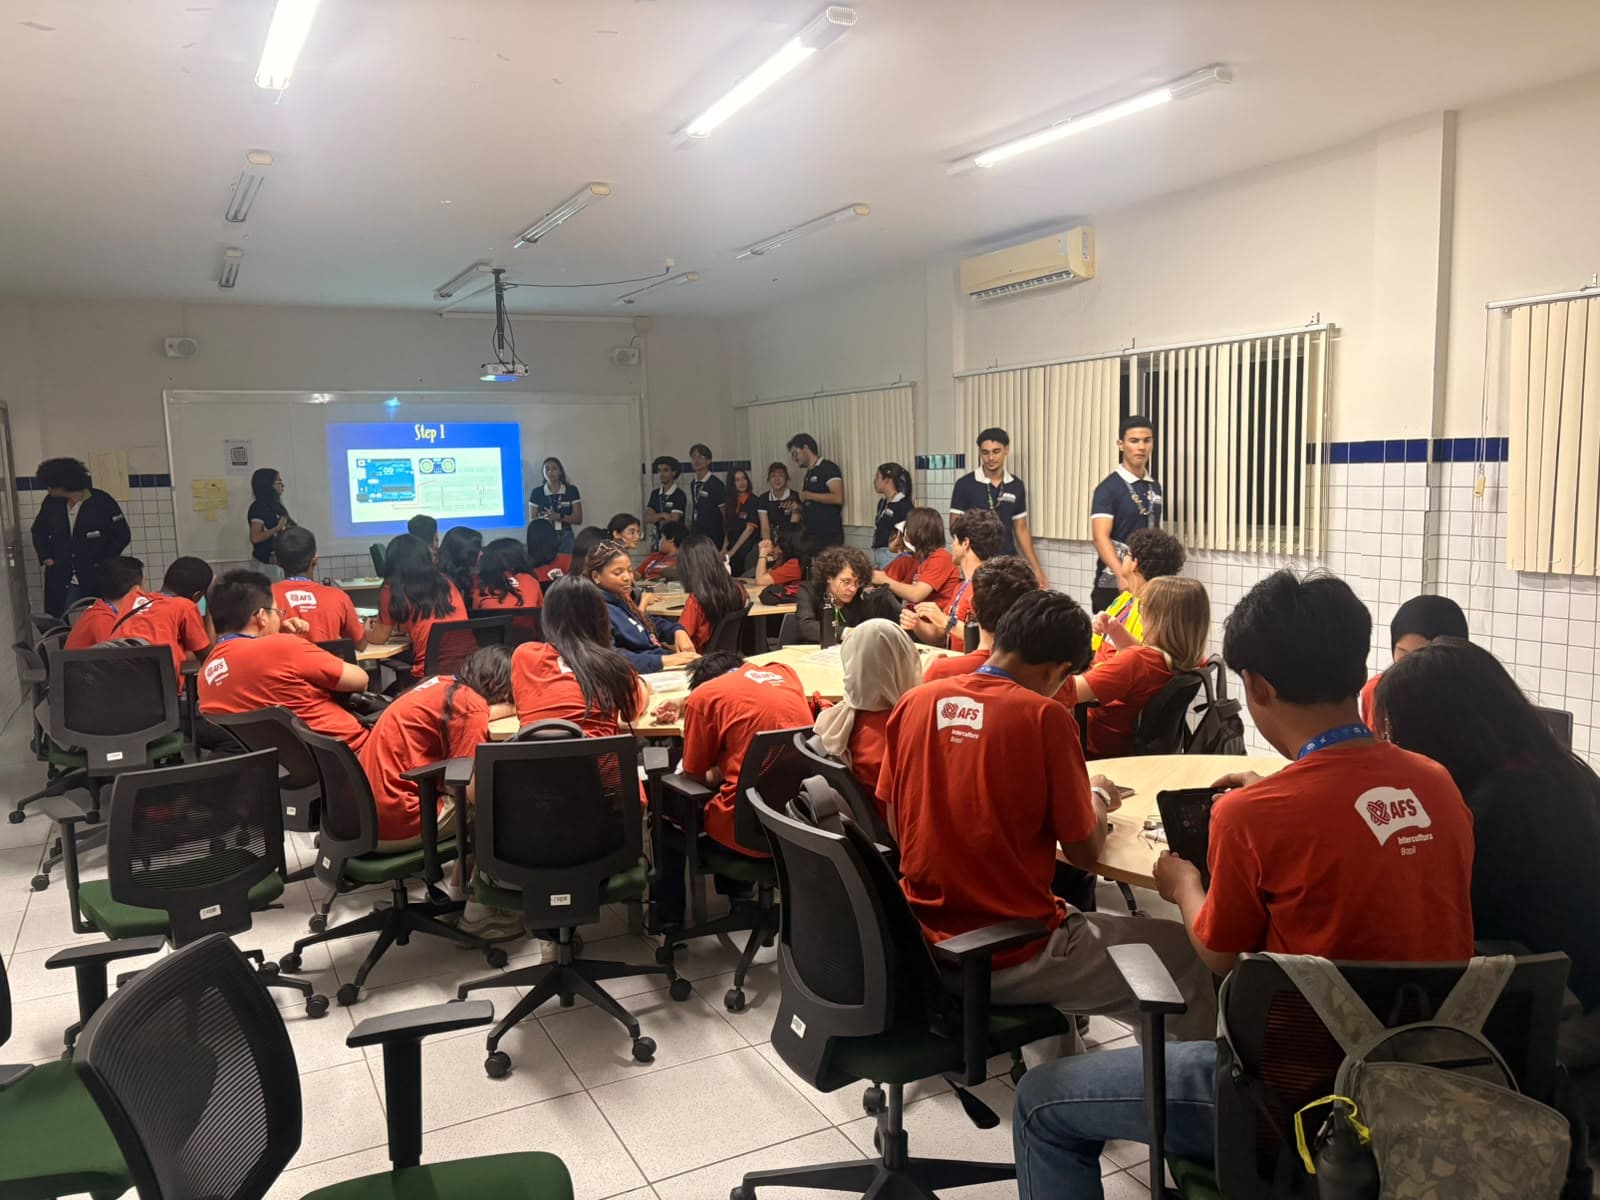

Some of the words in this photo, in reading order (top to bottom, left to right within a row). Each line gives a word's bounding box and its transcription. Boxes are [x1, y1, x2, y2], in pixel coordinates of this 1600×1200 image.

[414, 424, 437, 443] Step
[439, 424, 446, 439] 1
[213, 661, 224, 672] AFS
[957, 706, 980, 721] AFS
[1390, 798, 1417, 819] AFS
